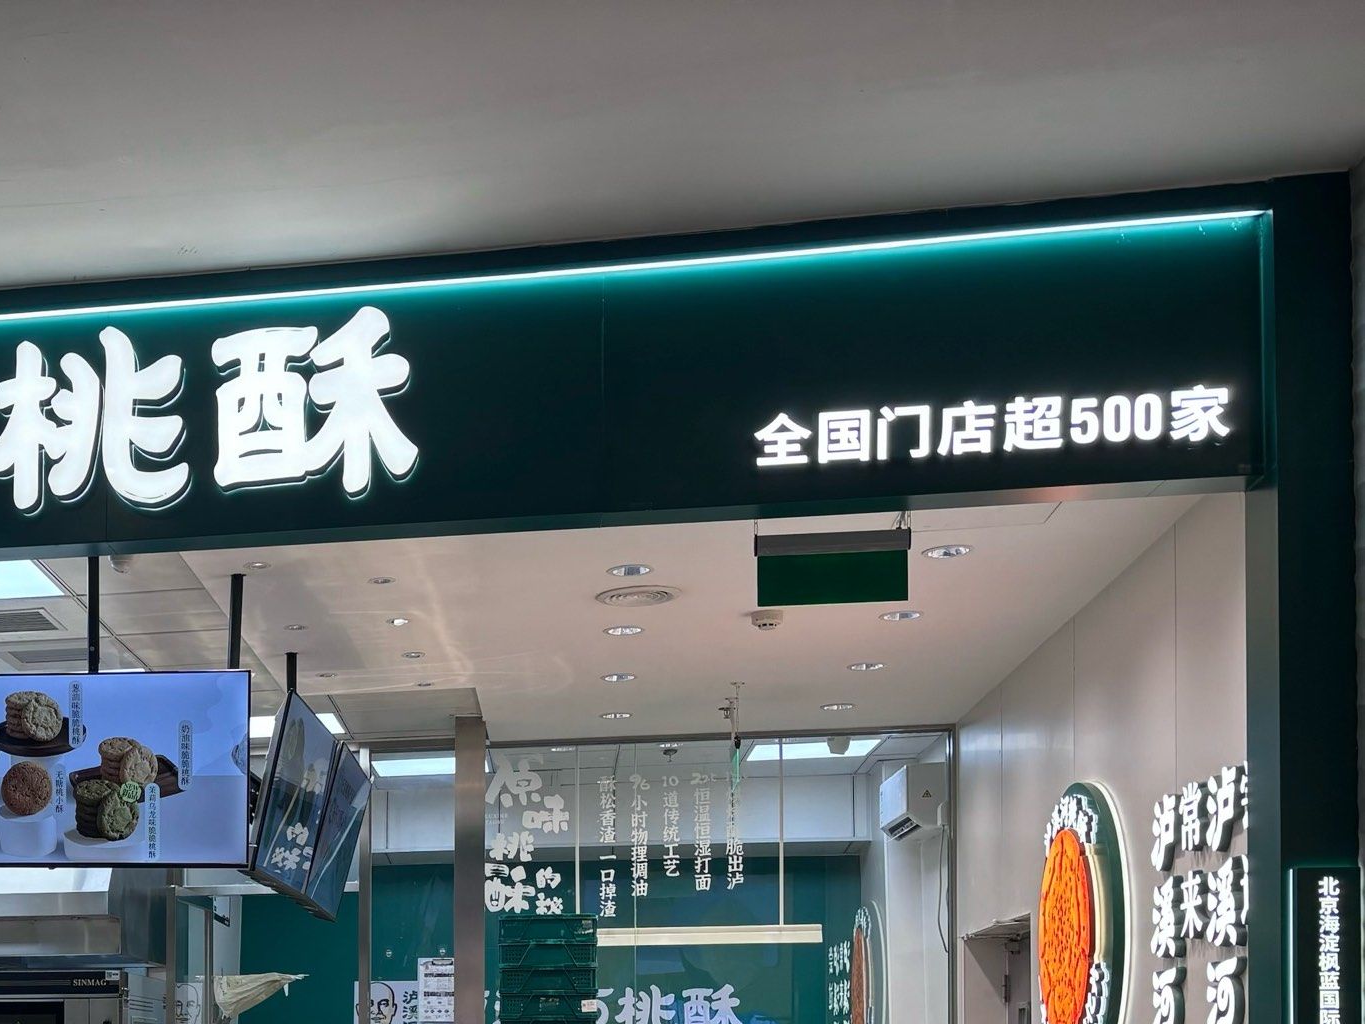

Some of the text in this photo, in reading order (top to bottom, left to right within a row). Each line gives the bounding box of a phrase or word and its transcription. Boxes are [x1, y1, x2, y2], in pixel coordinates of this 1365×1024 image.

[754, 384, 1231, 467] 全国门店超500家
[662, 776, 680, 877] 10道传统工艺
[1179, 781, 1204, 939] 常来
[599, 854, 617, 917] 一口掉渣
